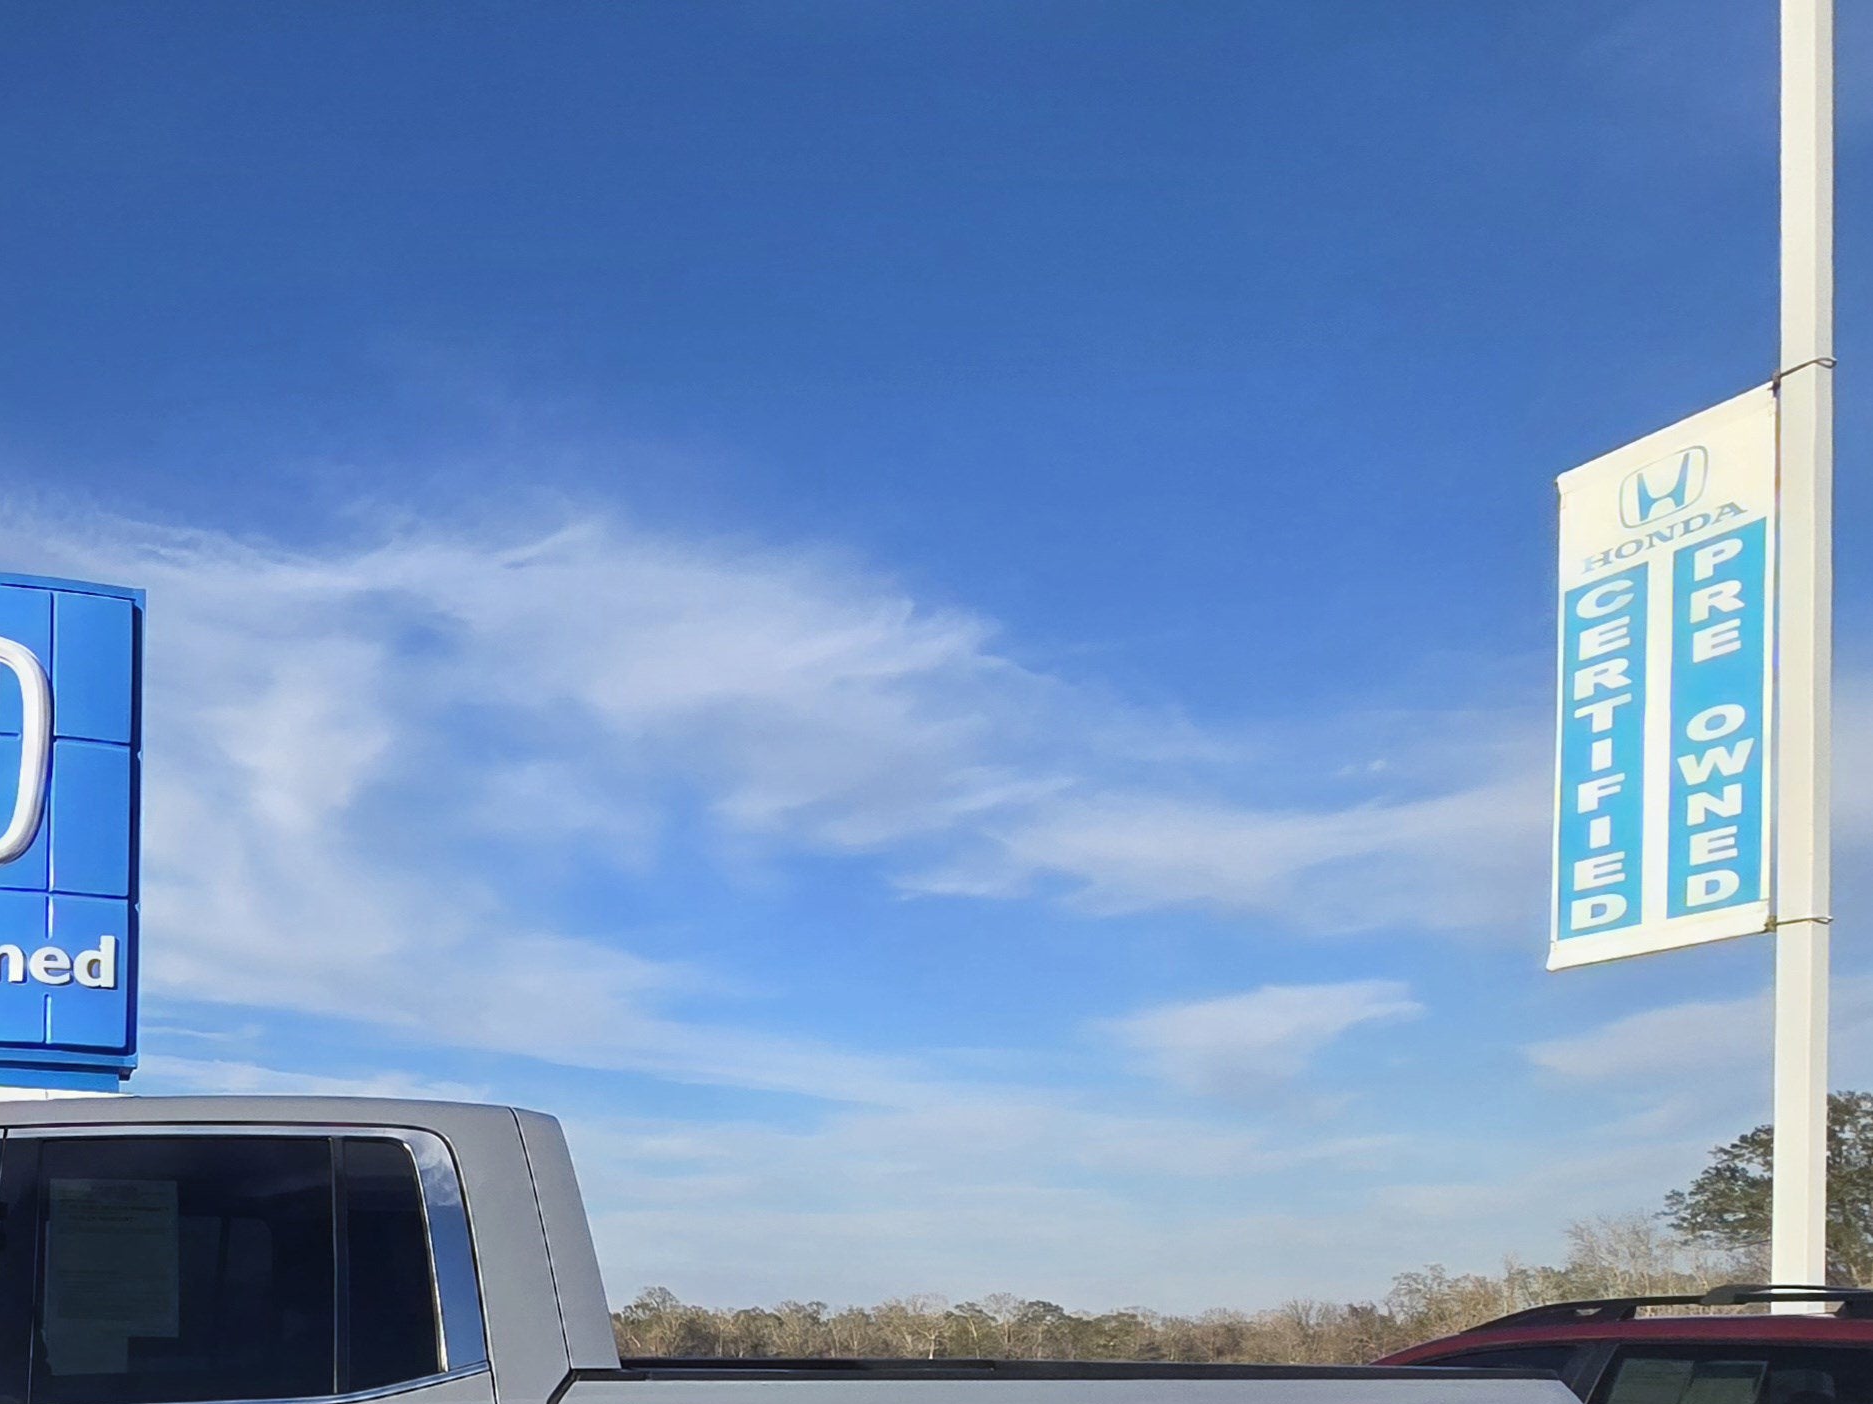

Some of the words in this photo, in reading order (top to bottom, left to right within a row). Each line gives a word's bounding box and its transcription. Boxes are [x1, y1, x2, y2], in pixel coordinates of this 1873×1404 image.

[1580, 500, 1748, 575] HONDA
[1689, 537, 1744, 663] PRE
[1570, 578, 1636, 932] CERTIFIED
[1676, 703, 1755, 908] OWNED
